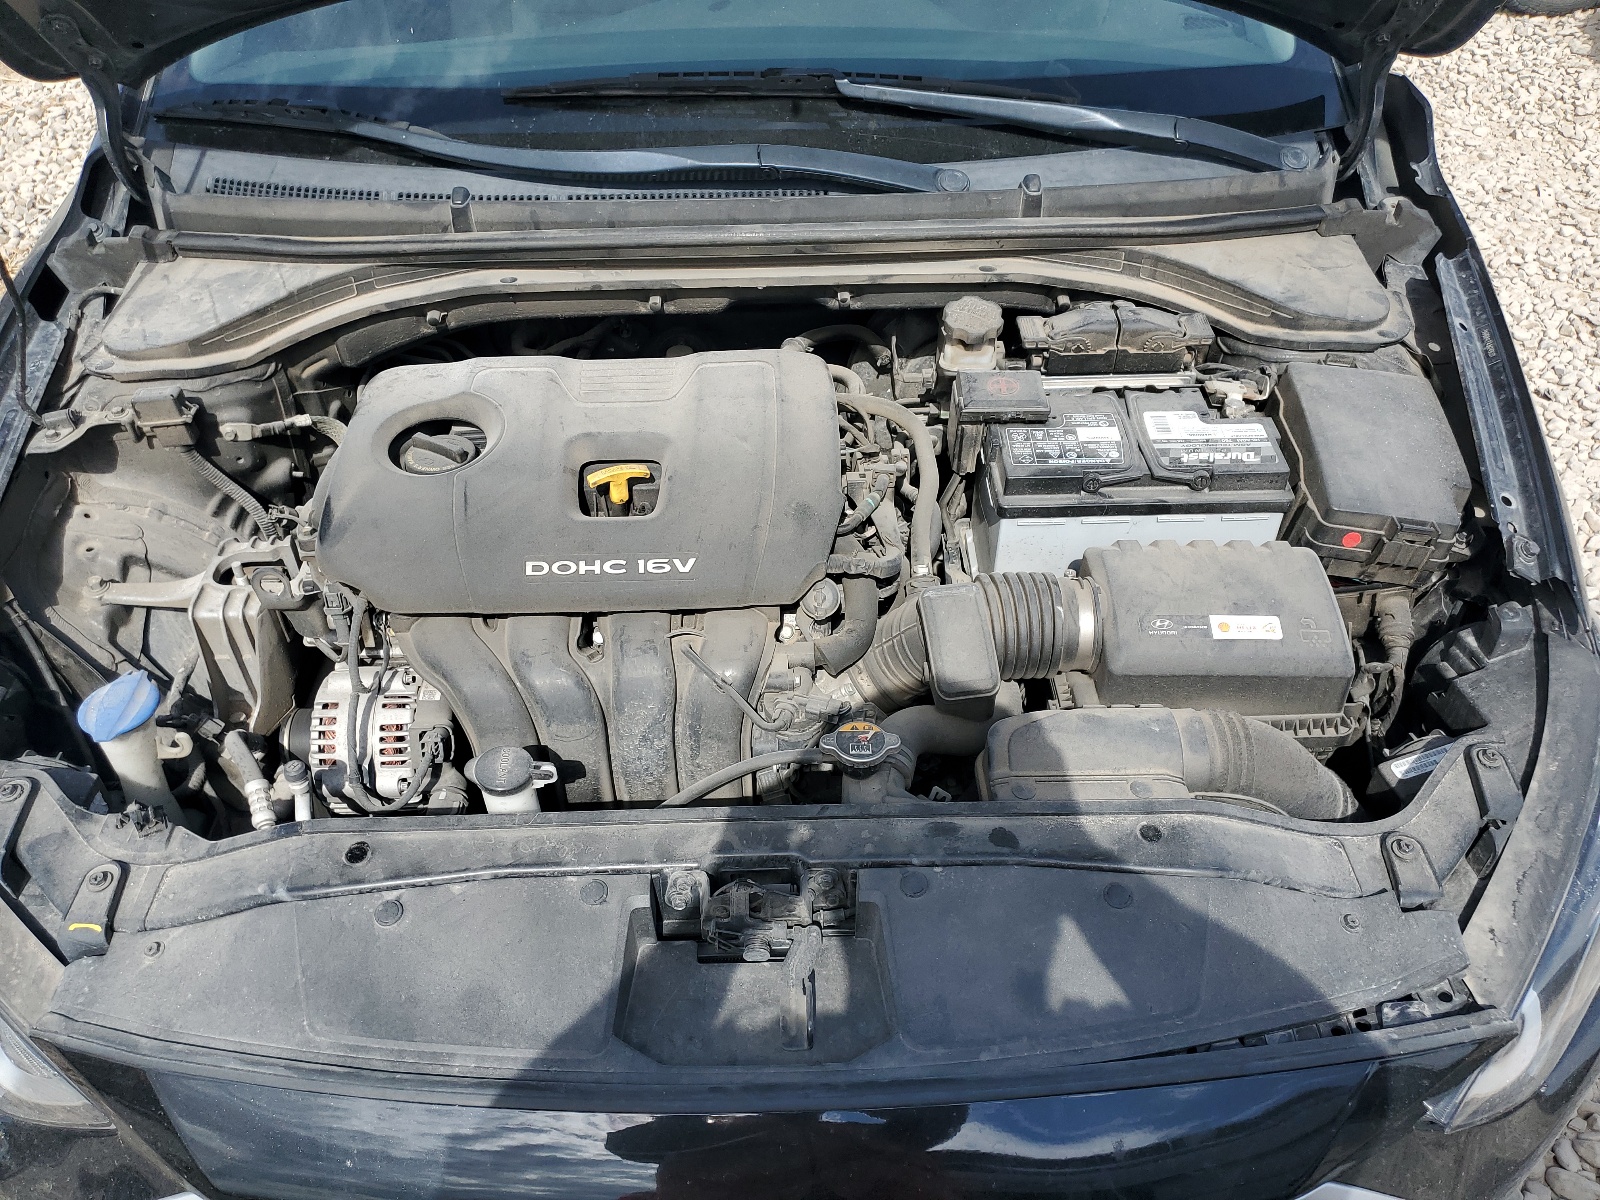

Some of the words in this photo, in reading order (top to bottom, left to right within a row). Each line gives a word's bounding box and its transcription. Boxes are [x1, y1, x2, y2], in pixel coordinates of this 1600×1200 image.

[1180, 451, 1261, 463] Duralast
[525, 560, 627, 576] DOHC
[637, 557, 697, 574] 16V
[496, 748, 511, 784] COOLANT
